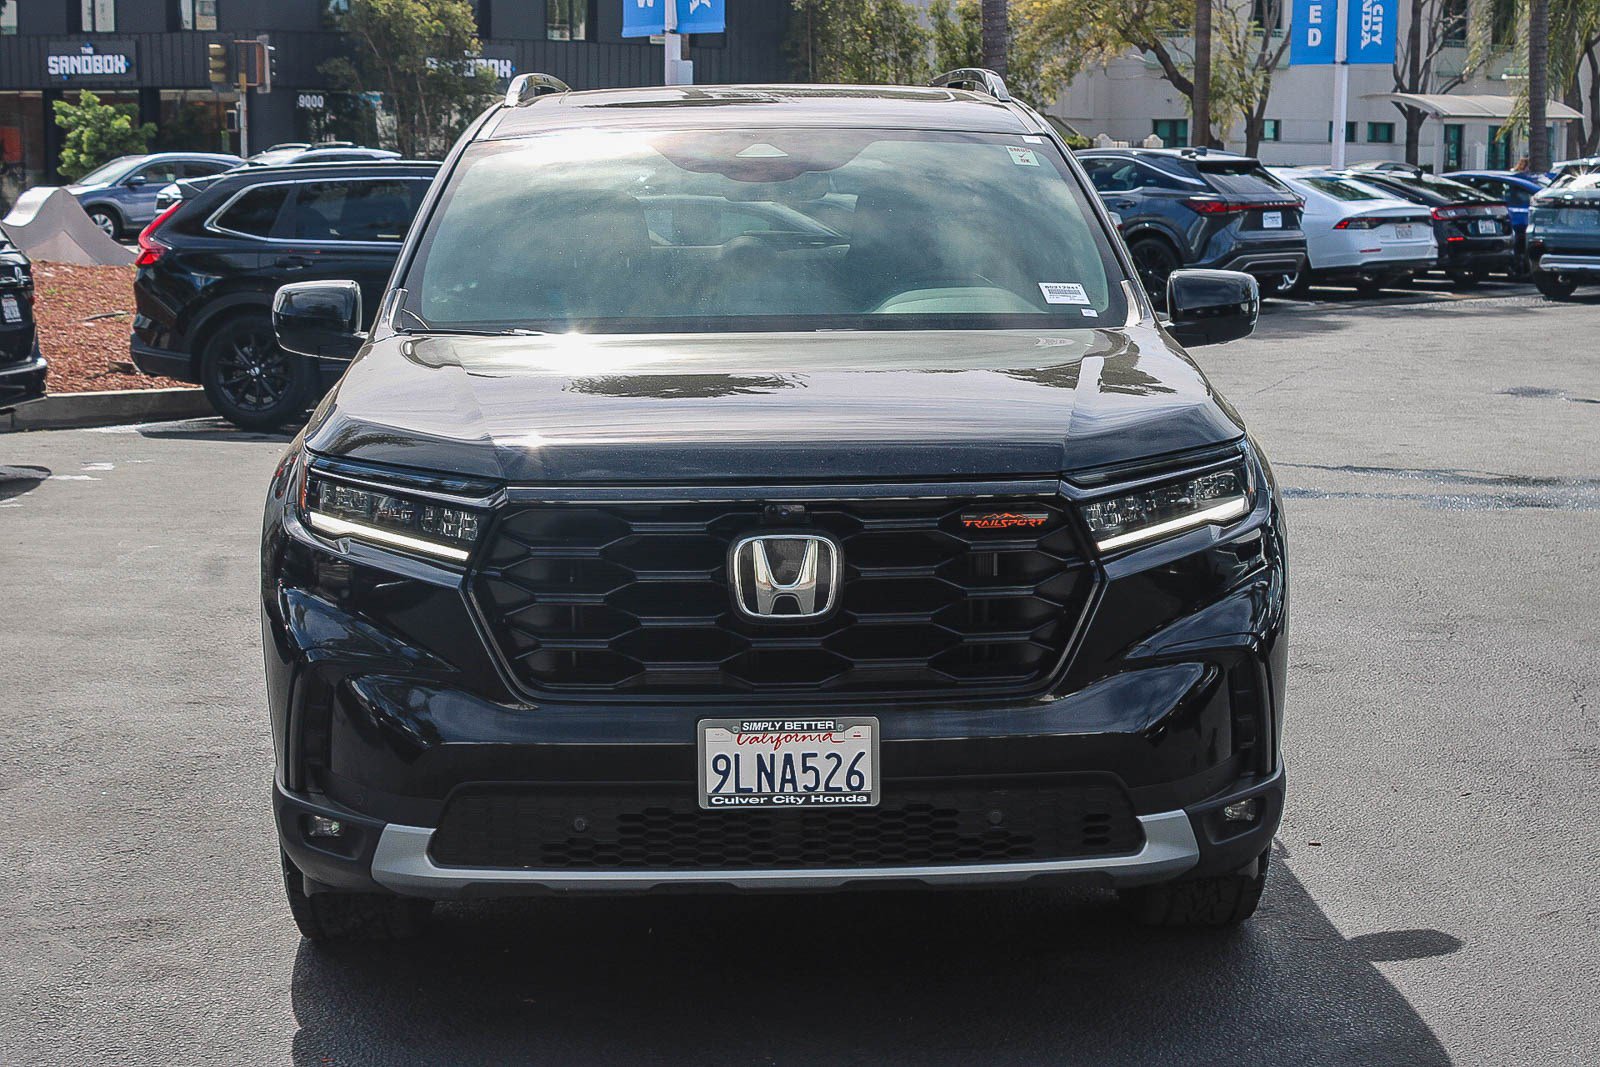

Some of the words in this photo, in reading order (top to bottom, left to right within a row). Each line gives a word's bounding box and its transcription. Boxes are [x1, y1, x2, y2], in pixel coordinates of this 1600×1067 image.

[47, 54, 127, 75] SANDBOX
[298, 94, 325, 108] 9000
[962, 518, 1047, 529] TRAILSPORT
[742, 721, 782, 732] SIMPLY
[784, 720, 834, 731] BETTER
[736, 732, 846, 751] California
[711, 751, 866, 794] 9LNA526
[711, 795, 768, 805] Culver
[772, 794, 806, 805] City
[811, 794, 868, 804] Honda
